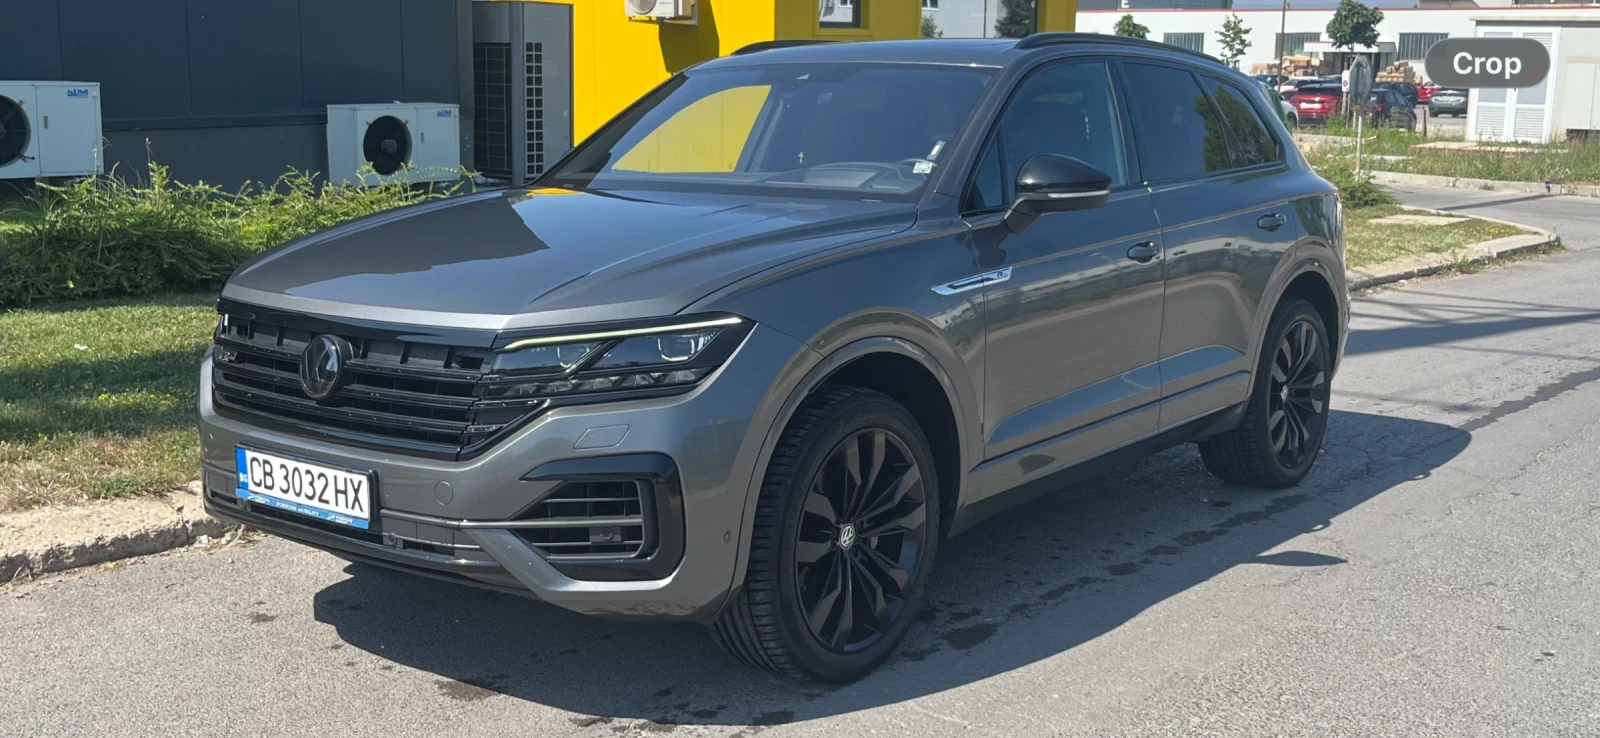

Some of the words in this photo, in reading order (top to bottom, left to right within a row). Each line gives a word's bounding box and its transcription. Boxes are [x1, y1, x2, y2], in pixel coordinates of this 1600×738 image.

[250, 456, 275, 491] CB
[279, 463, 330, 505] 3032
[333, 474, 364, 513] HX
